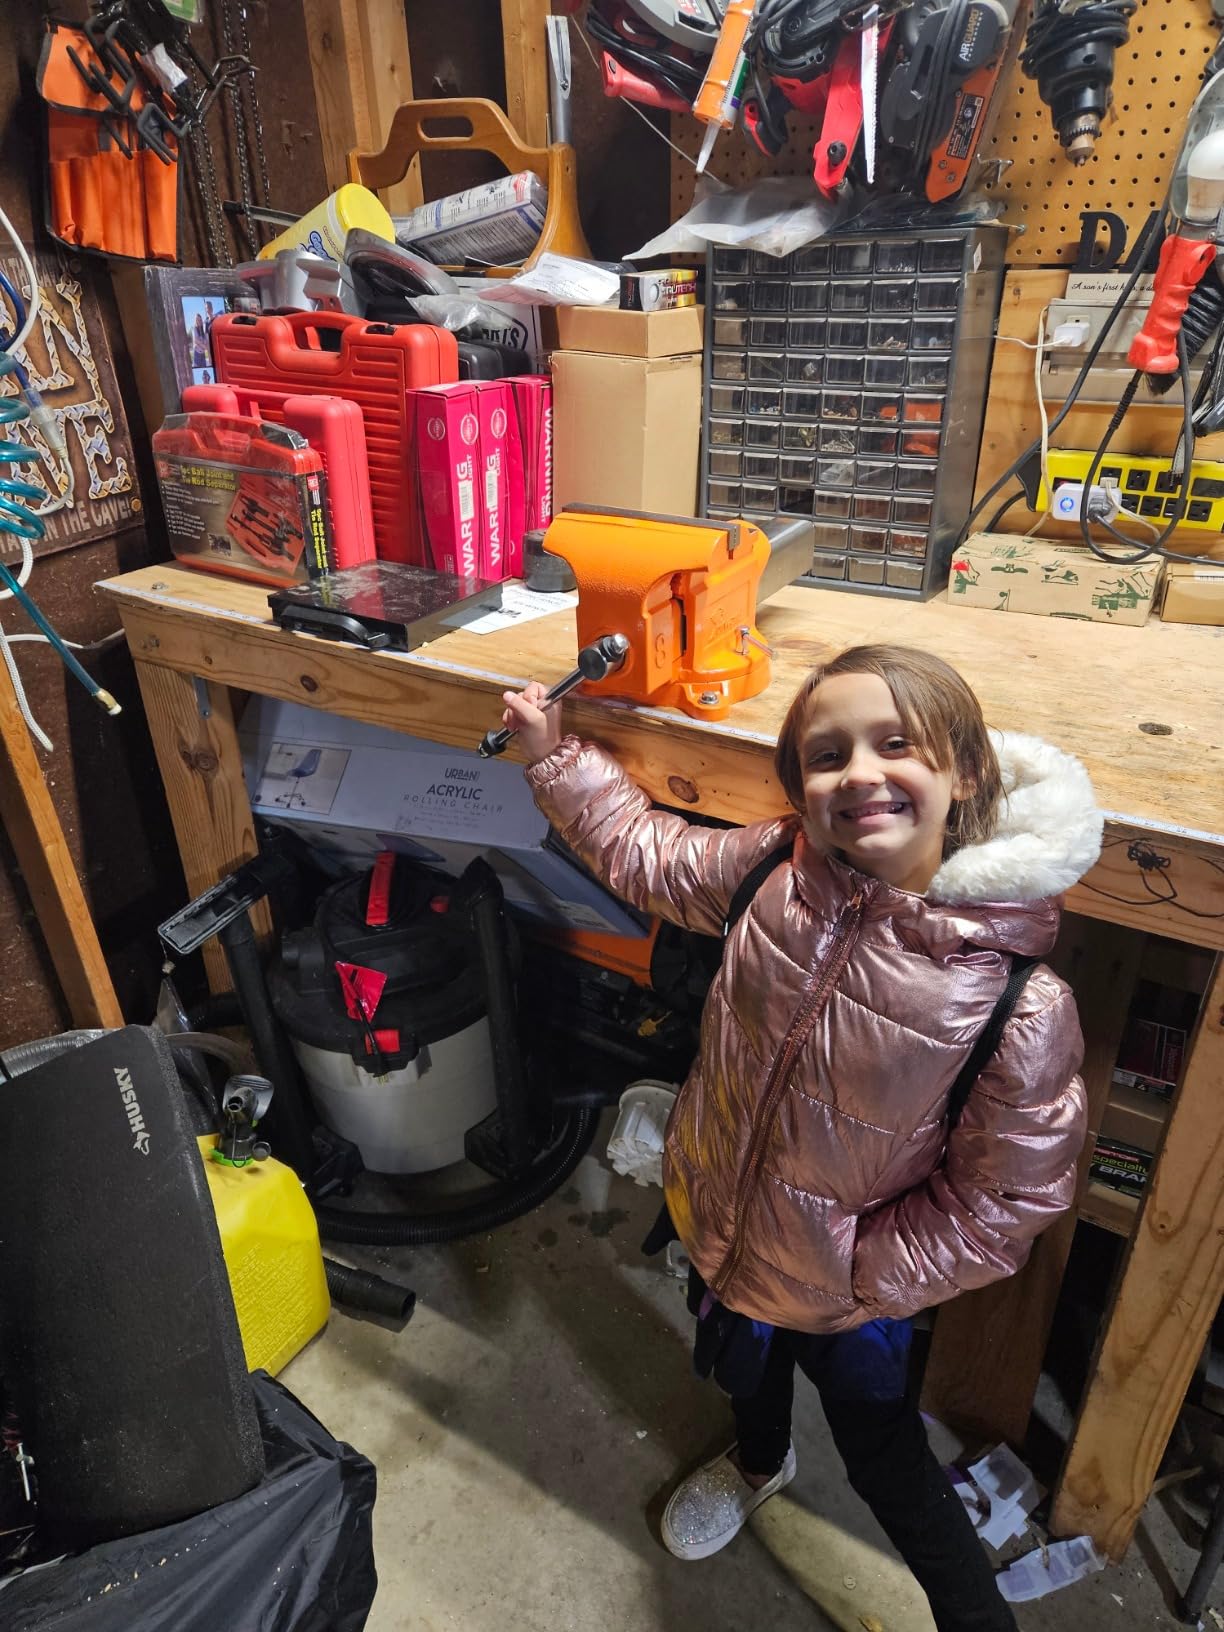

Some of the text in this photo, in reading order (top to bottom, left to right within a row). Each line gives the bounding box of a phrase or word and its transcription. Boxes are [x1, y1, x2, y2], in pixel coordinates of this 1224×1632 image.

[958, 8, 980, 62] AIRGUARD
[1071, 281, 1083, 290] A
[1082, 281, 1101, 291] son's
[1102, 281, 1119, 293] first
[206, 479, 236, 492] Separator
[61, 505, 91, 535] THE
[91, 495, 132, 527] CAVE!
[457, 461, 474, 576] WARG
[485, 455, 500, 567] WARG
[403, 794, 504, 815] ROLLING CHAIR
[426, 784, 484, 800] ACRYLIC
[112, 1067, 146, 1133] HUSKY
